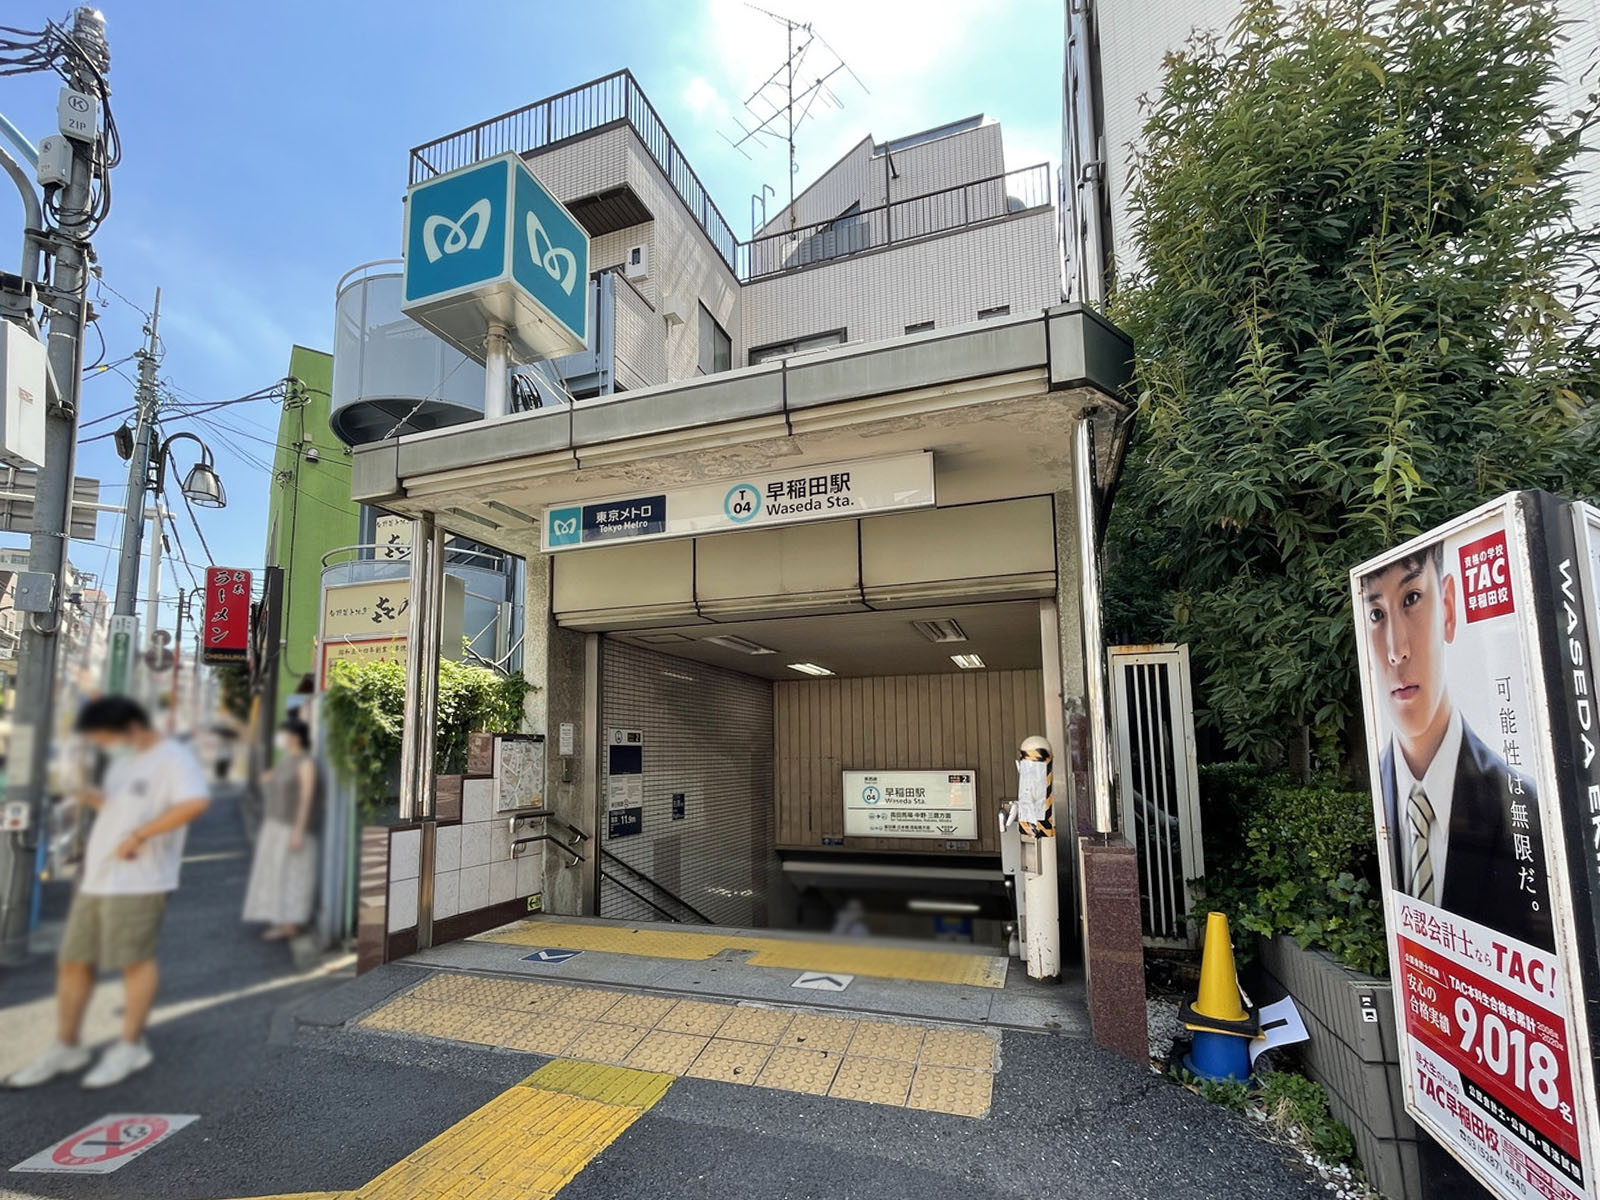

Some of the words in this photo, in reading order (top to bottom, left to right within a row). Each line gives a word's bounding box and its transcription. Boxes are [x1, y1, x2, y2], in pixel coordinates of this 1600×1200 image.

[69, 118, 87, 131] ZIP
[738, 490, 746, 501] T
[766, 472, 851, 501] 早稲田駅
[596, 505, 652, 524] 東京メトロ
[733, 501, 752, 514] 04
[766, 498, 822, 516] Waseda
[827, 495, 854, 509] Sta.
[599, 523, 623, 534] Tokyo
[624, 520, 649, 531] Metro
[1464, 544, 1504, 569] 資格の学校
[1465, 557, 1506, 593] TAC
[211, 571, 231, 643] ラーメン
[1468, 587, 1509, 610] 早稲田校
[1558, 558, 1596, 769] WASEDA
[885, 787, 926, 798] 早稲田駅
[1495, 676, 1540, 912] 可能性は無限だ。
[1407, 973, 1437, 1003] 安心の
[1410, 995, 1451, 1037] 合格実績
[1448, 975, 1537, 1035] TAC本科生合格者累計
[1415, 1050, 1460, 1095] 早大生のための
[1417, 1068, 1501, 1156] TAC早稲田校
